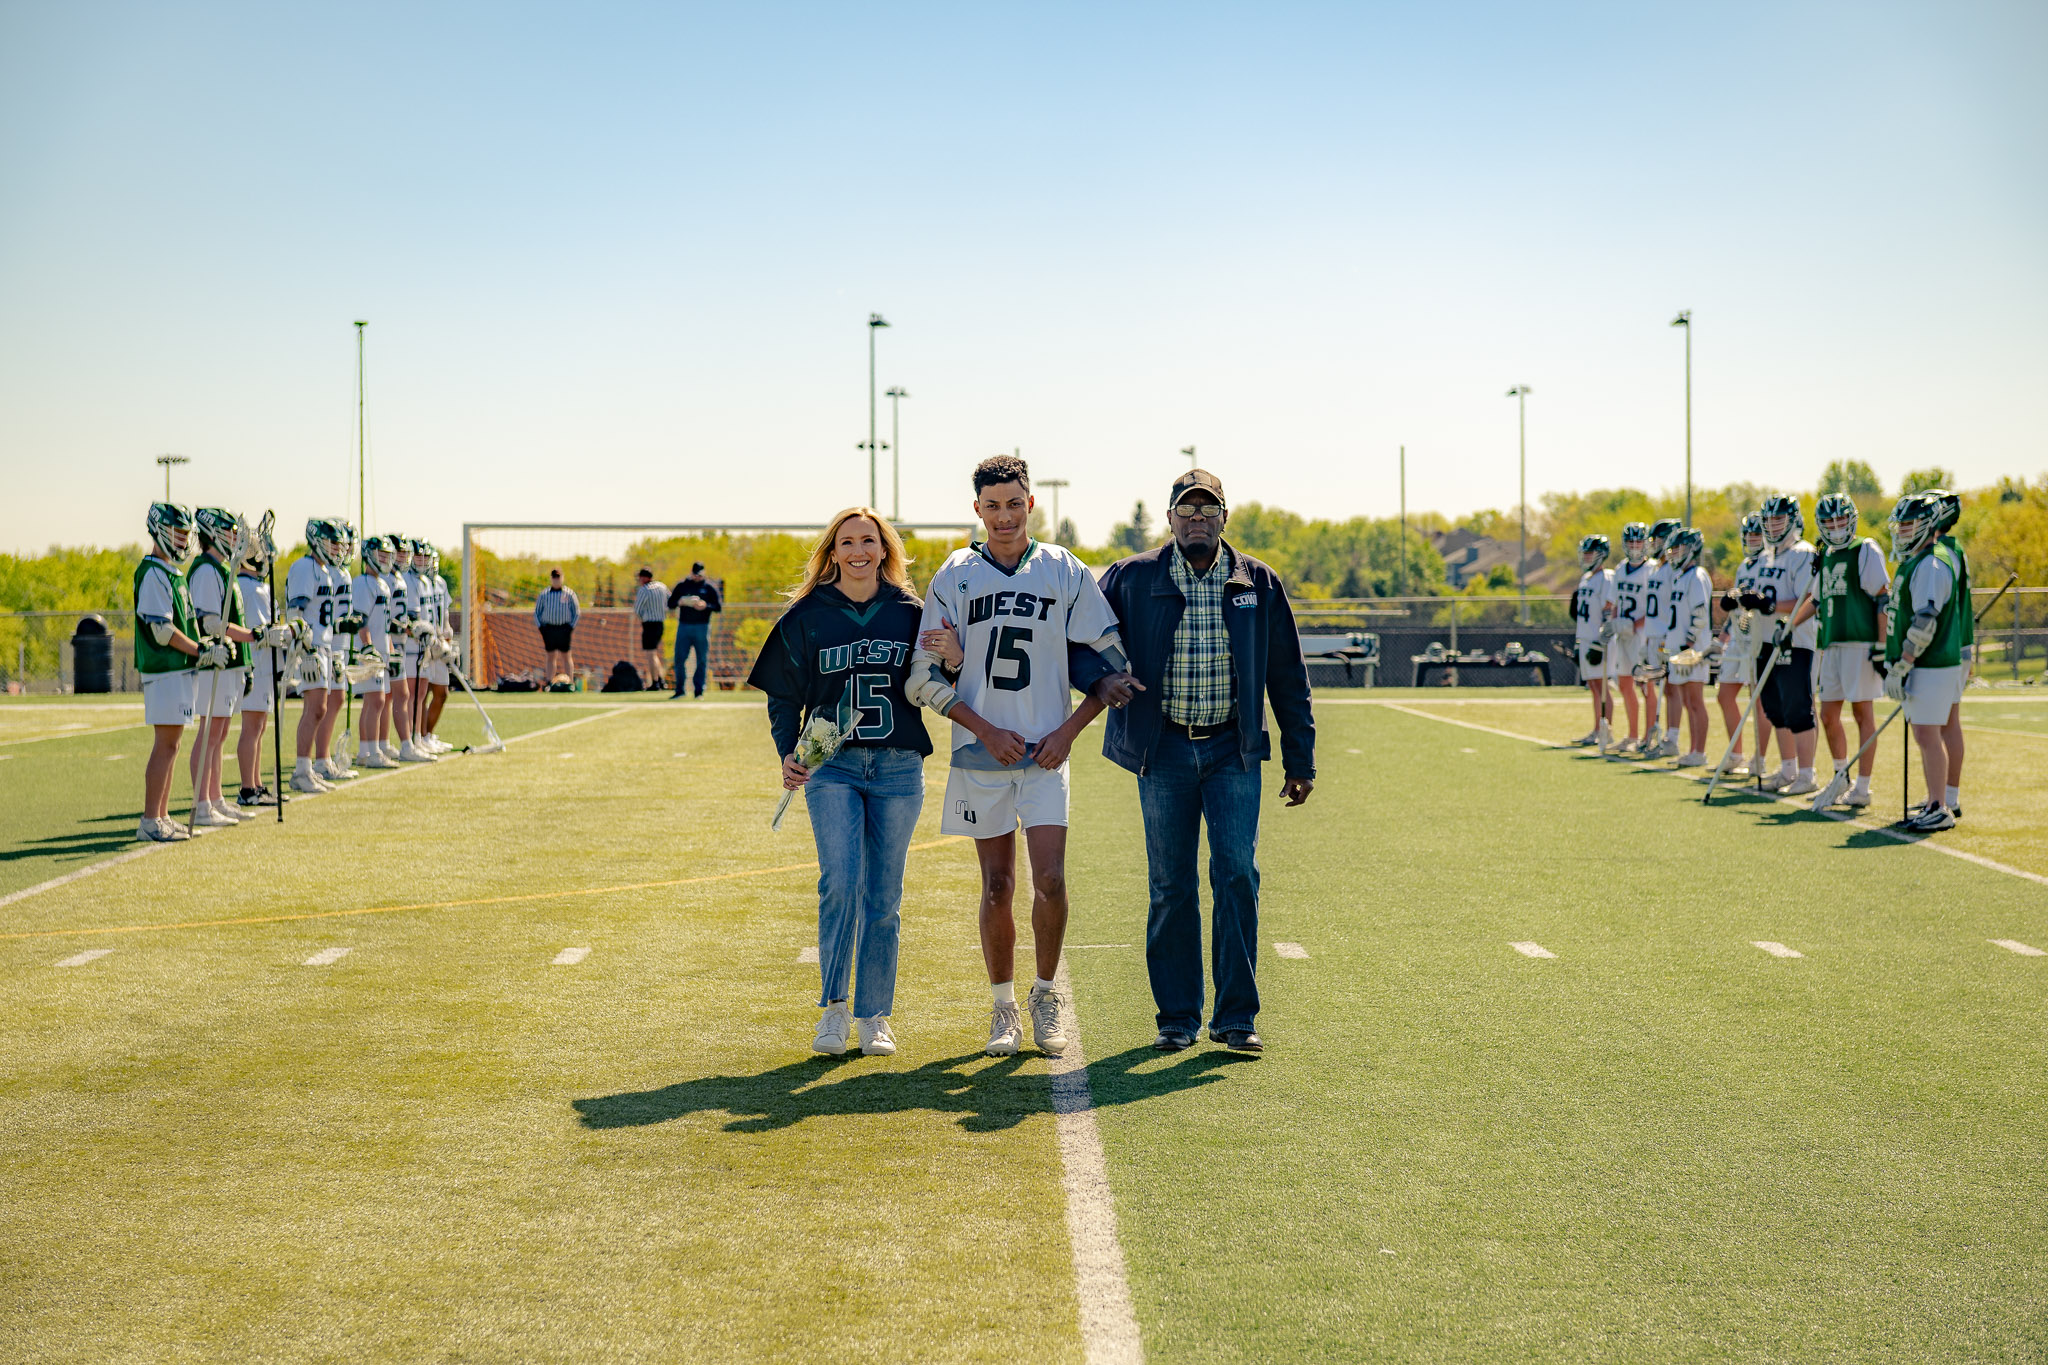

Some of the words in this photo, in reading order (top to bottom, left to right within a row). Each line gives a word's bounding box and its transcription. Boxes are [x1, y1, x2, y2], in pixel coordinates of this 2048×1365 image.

[967, 591, 1057, 626] WEST
[819, 639, 910, 675] WEST
[985, 625, 1033, 692] 15
[837, 673, 895, 741] 15
